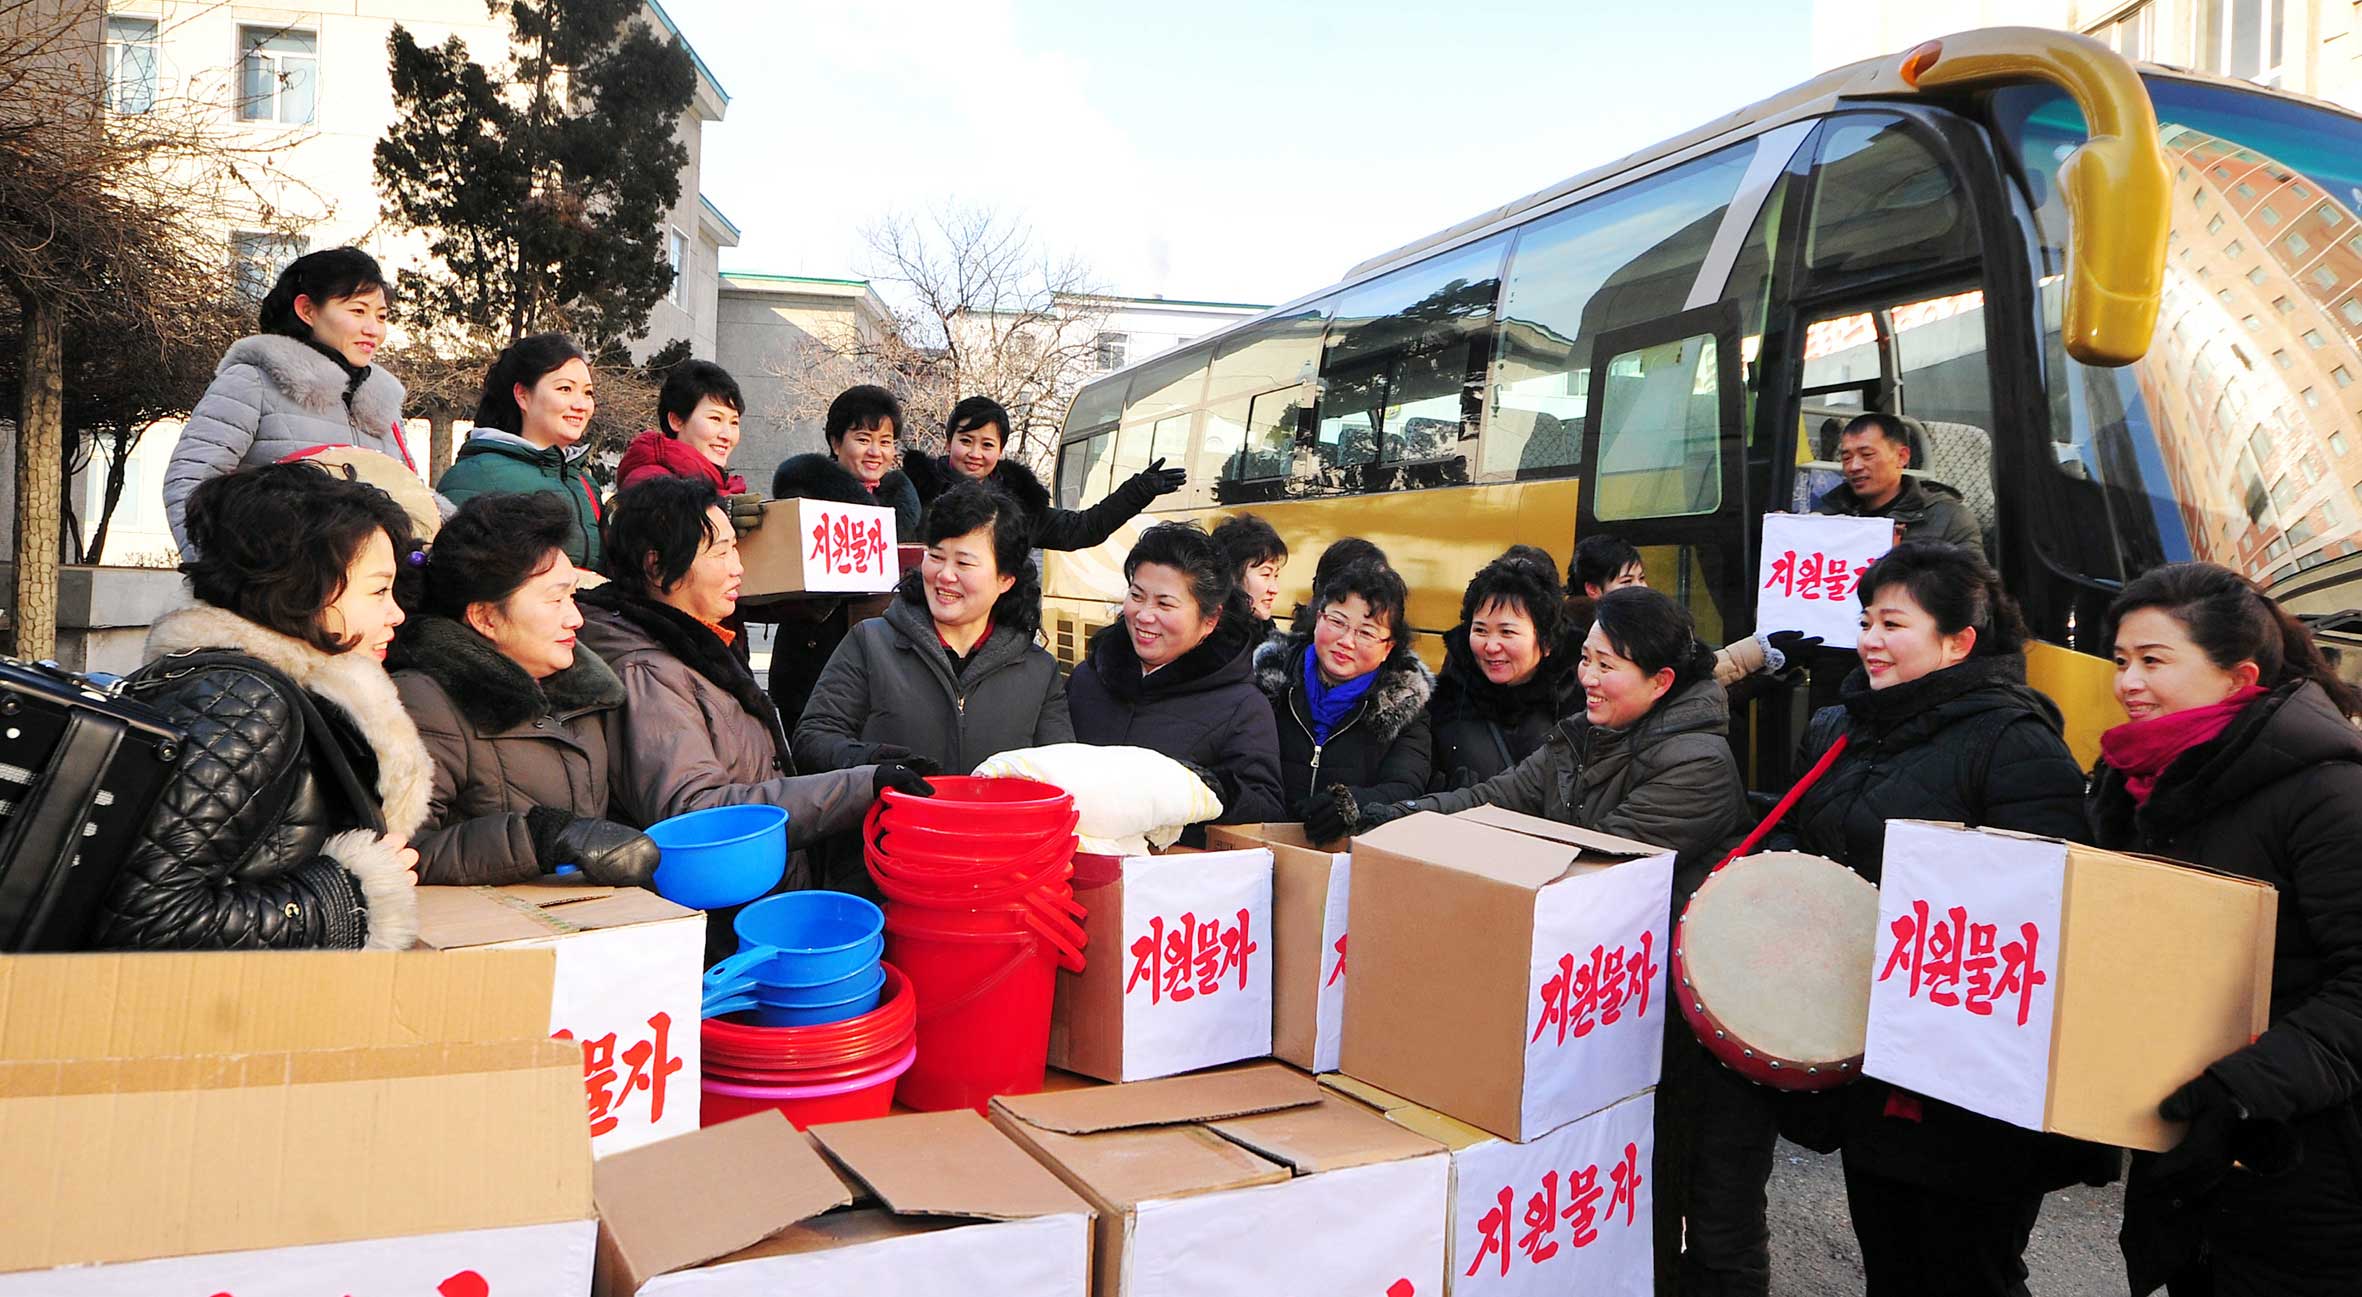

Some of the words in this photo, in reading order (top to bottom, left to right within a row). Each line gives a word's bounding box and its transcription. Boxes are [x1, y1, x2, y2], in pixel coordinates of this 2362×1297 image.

[810, 511, 888, 577] 지원물자
[1125, 907, 1258, 1006] 지원물자
[1530, 930, 1658, 1047] 지원물자
[1878, 898, 2047, 1028] 지원물자
[551, 1010, 683, 1138] 물자
[1465, 1141, 1643, 1278] 지원물자
